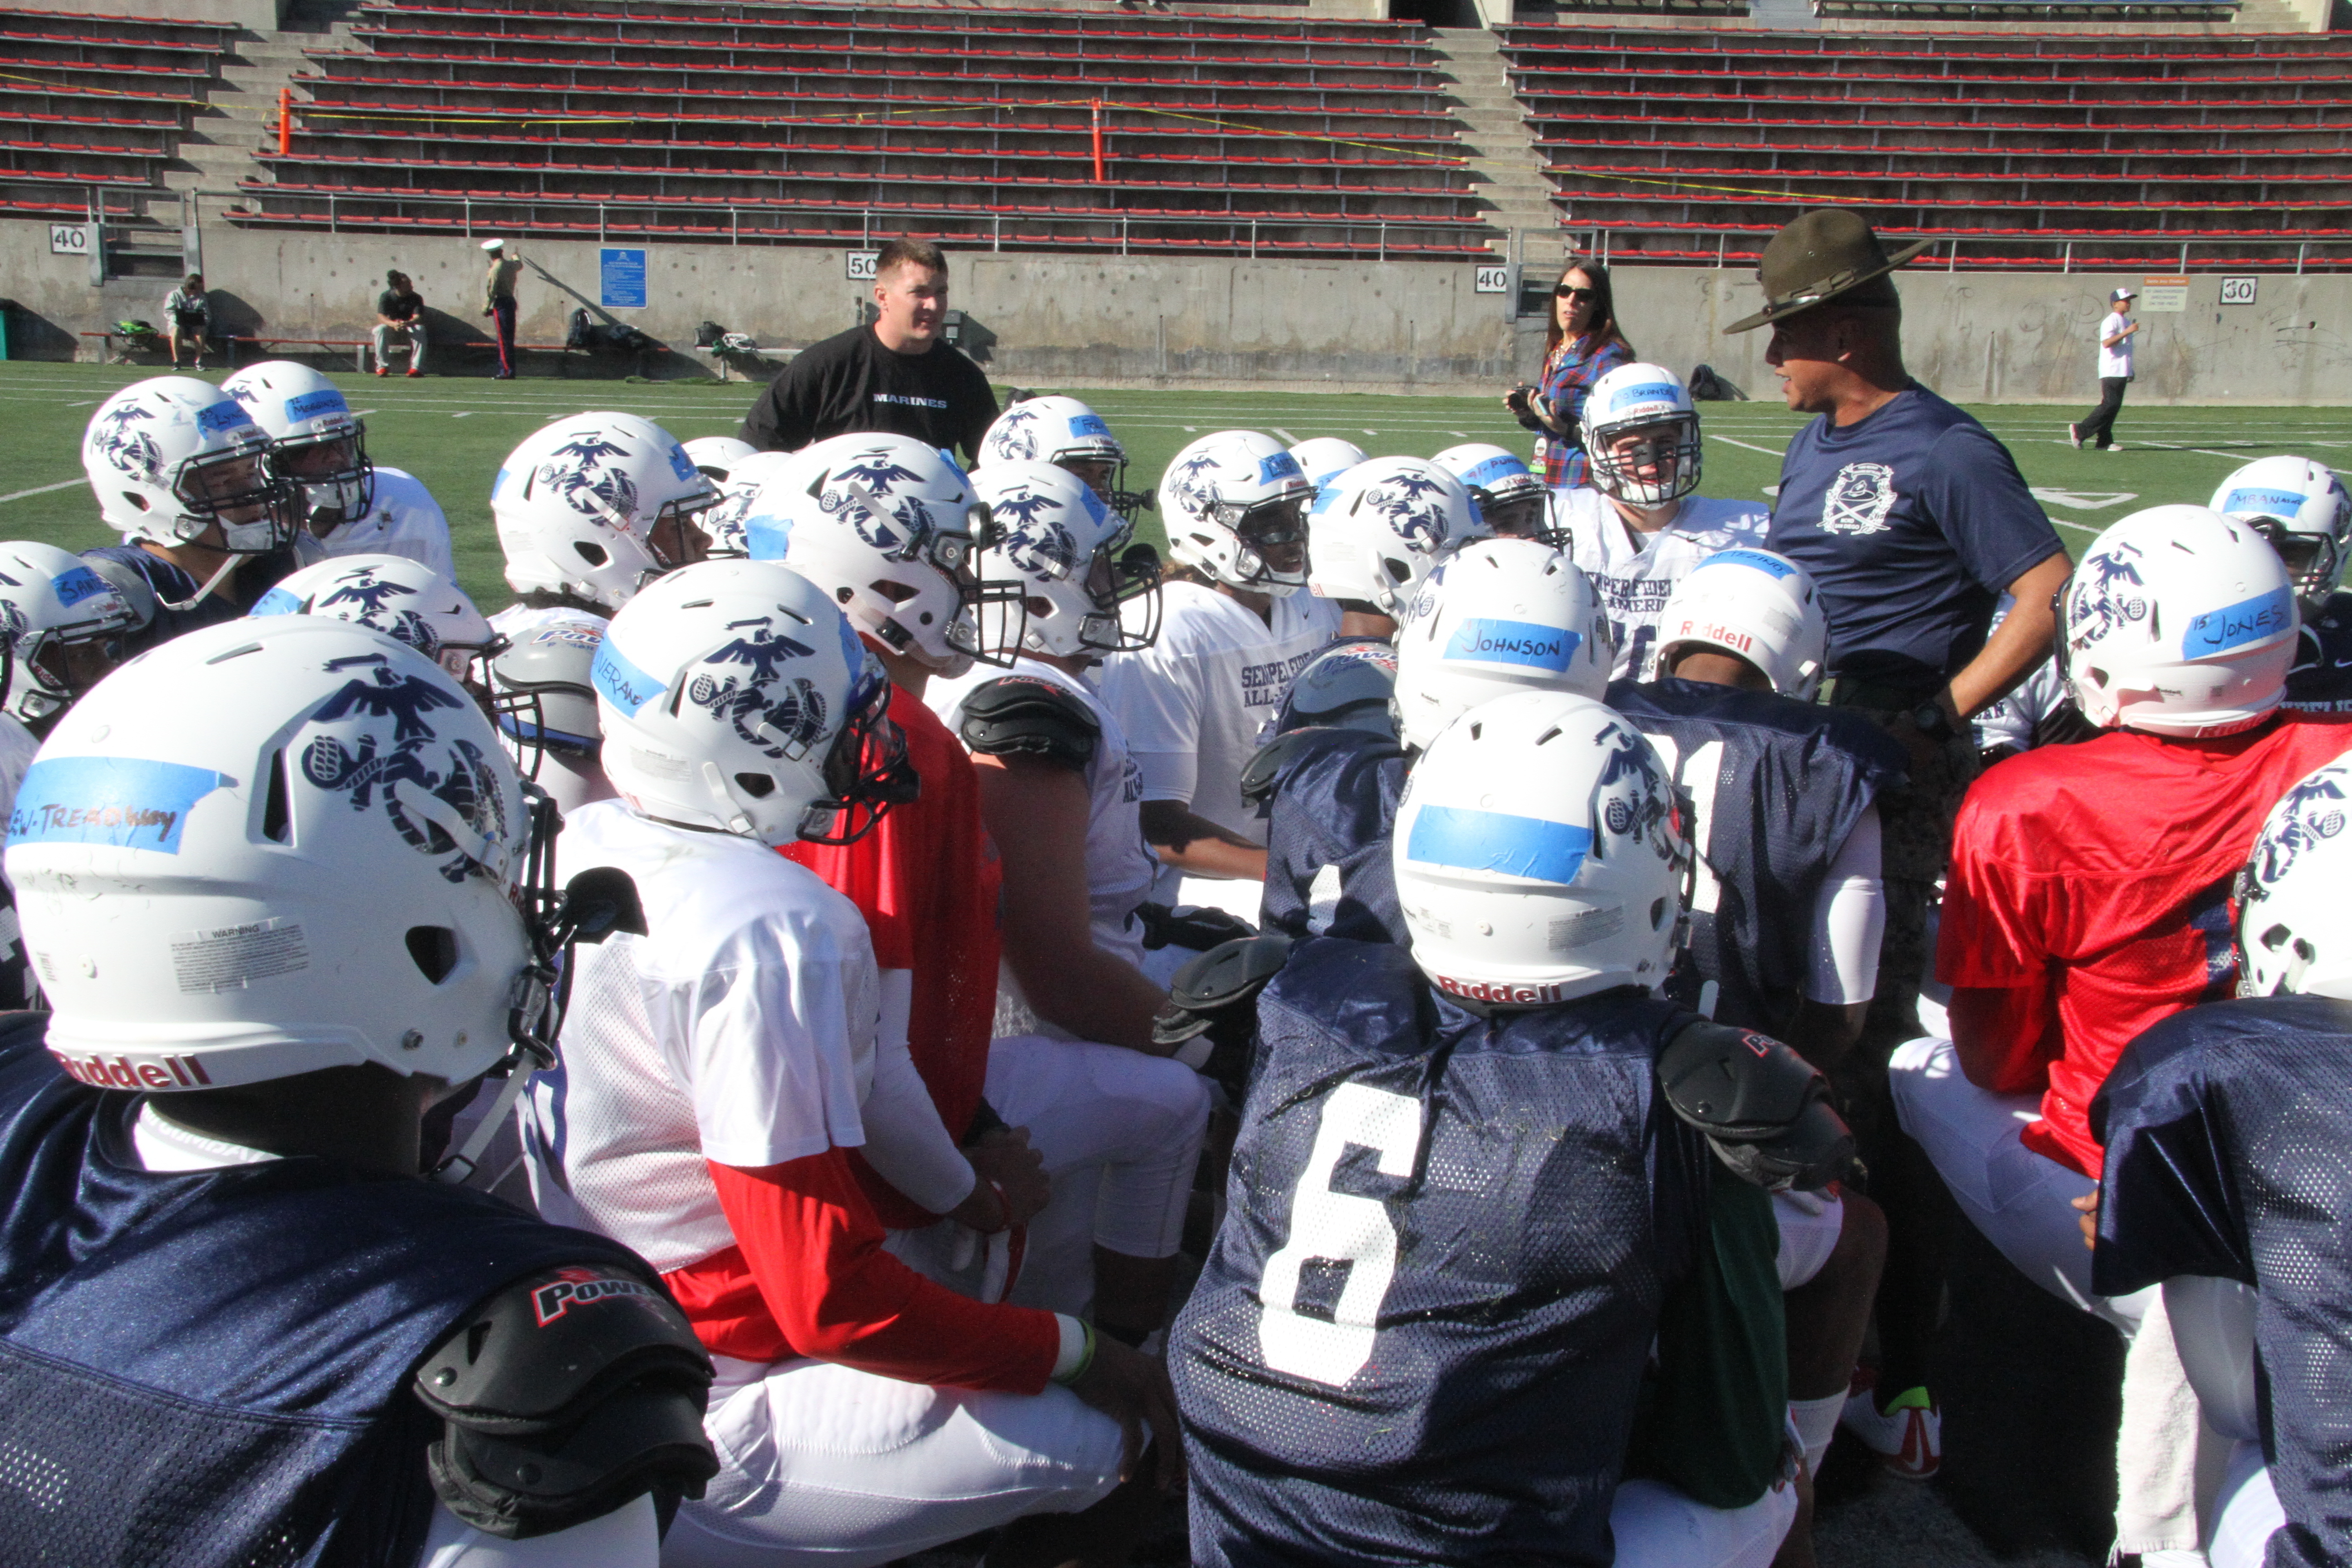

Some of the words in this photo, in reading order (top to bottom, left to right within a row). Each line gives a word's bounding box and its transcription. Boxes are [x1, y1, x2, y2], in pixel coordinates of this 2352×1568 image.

[54, 230, 85, 248] 40
[851, 258, 877, 274] 50
[1479, 271, 1506, 287] 40
[2225, 281, 2251, 298] 30
[873, 393, 947, 408] MARINES
[2194, 614, 2210, 631] 15
[2204, 604, 2283, 644] JONES
[1462, 629, 1560, 656] JOHNSON
[212, 924, 260, 938] WARNING
[1436, 975, 1562, 1003] Riddell
[44, 1049, 212, 1088] Riddell
[1258, 1083, 1421, 1387] 6
